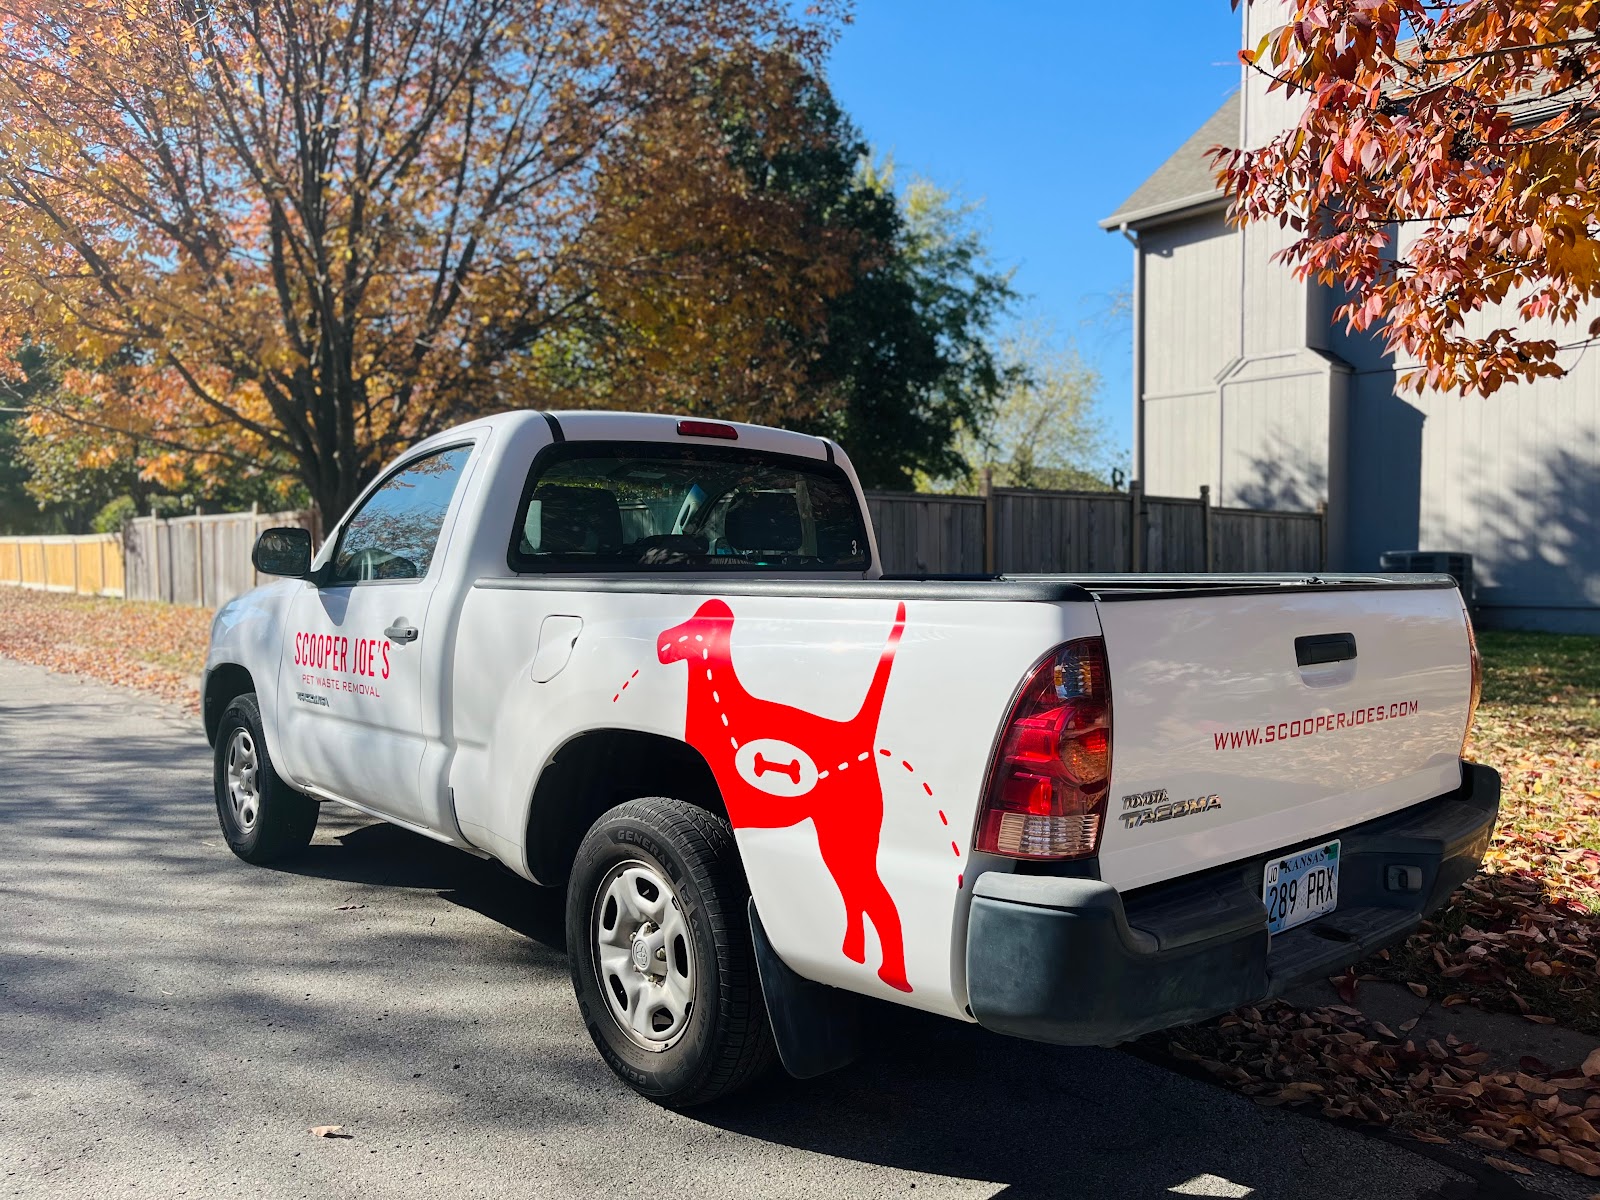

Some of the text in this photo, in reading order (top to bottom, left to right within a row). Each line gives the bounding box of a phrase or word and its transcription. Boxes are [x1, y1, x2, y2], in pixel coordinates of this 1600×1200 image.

[851, 539, 858, 556] 3
[294, 631, 391, 680] SCOOPER JOE'S
[302, 674, 381, 698] PET WASTE REMOVAL
[1213, 700, 1419, 751] WWW.SCOOPERJOES.COM
[1118, 793, 1222, 830] TACOMA
[1121, 788, 1170, 811] TOYOTA
[616, 829, 675, 875] GENERAL
[1283, 848, 1326, 875] KANSAS
[1268, 866, 1279, 885] JO
[1267, 865, 1335, 924] 289 PRX
